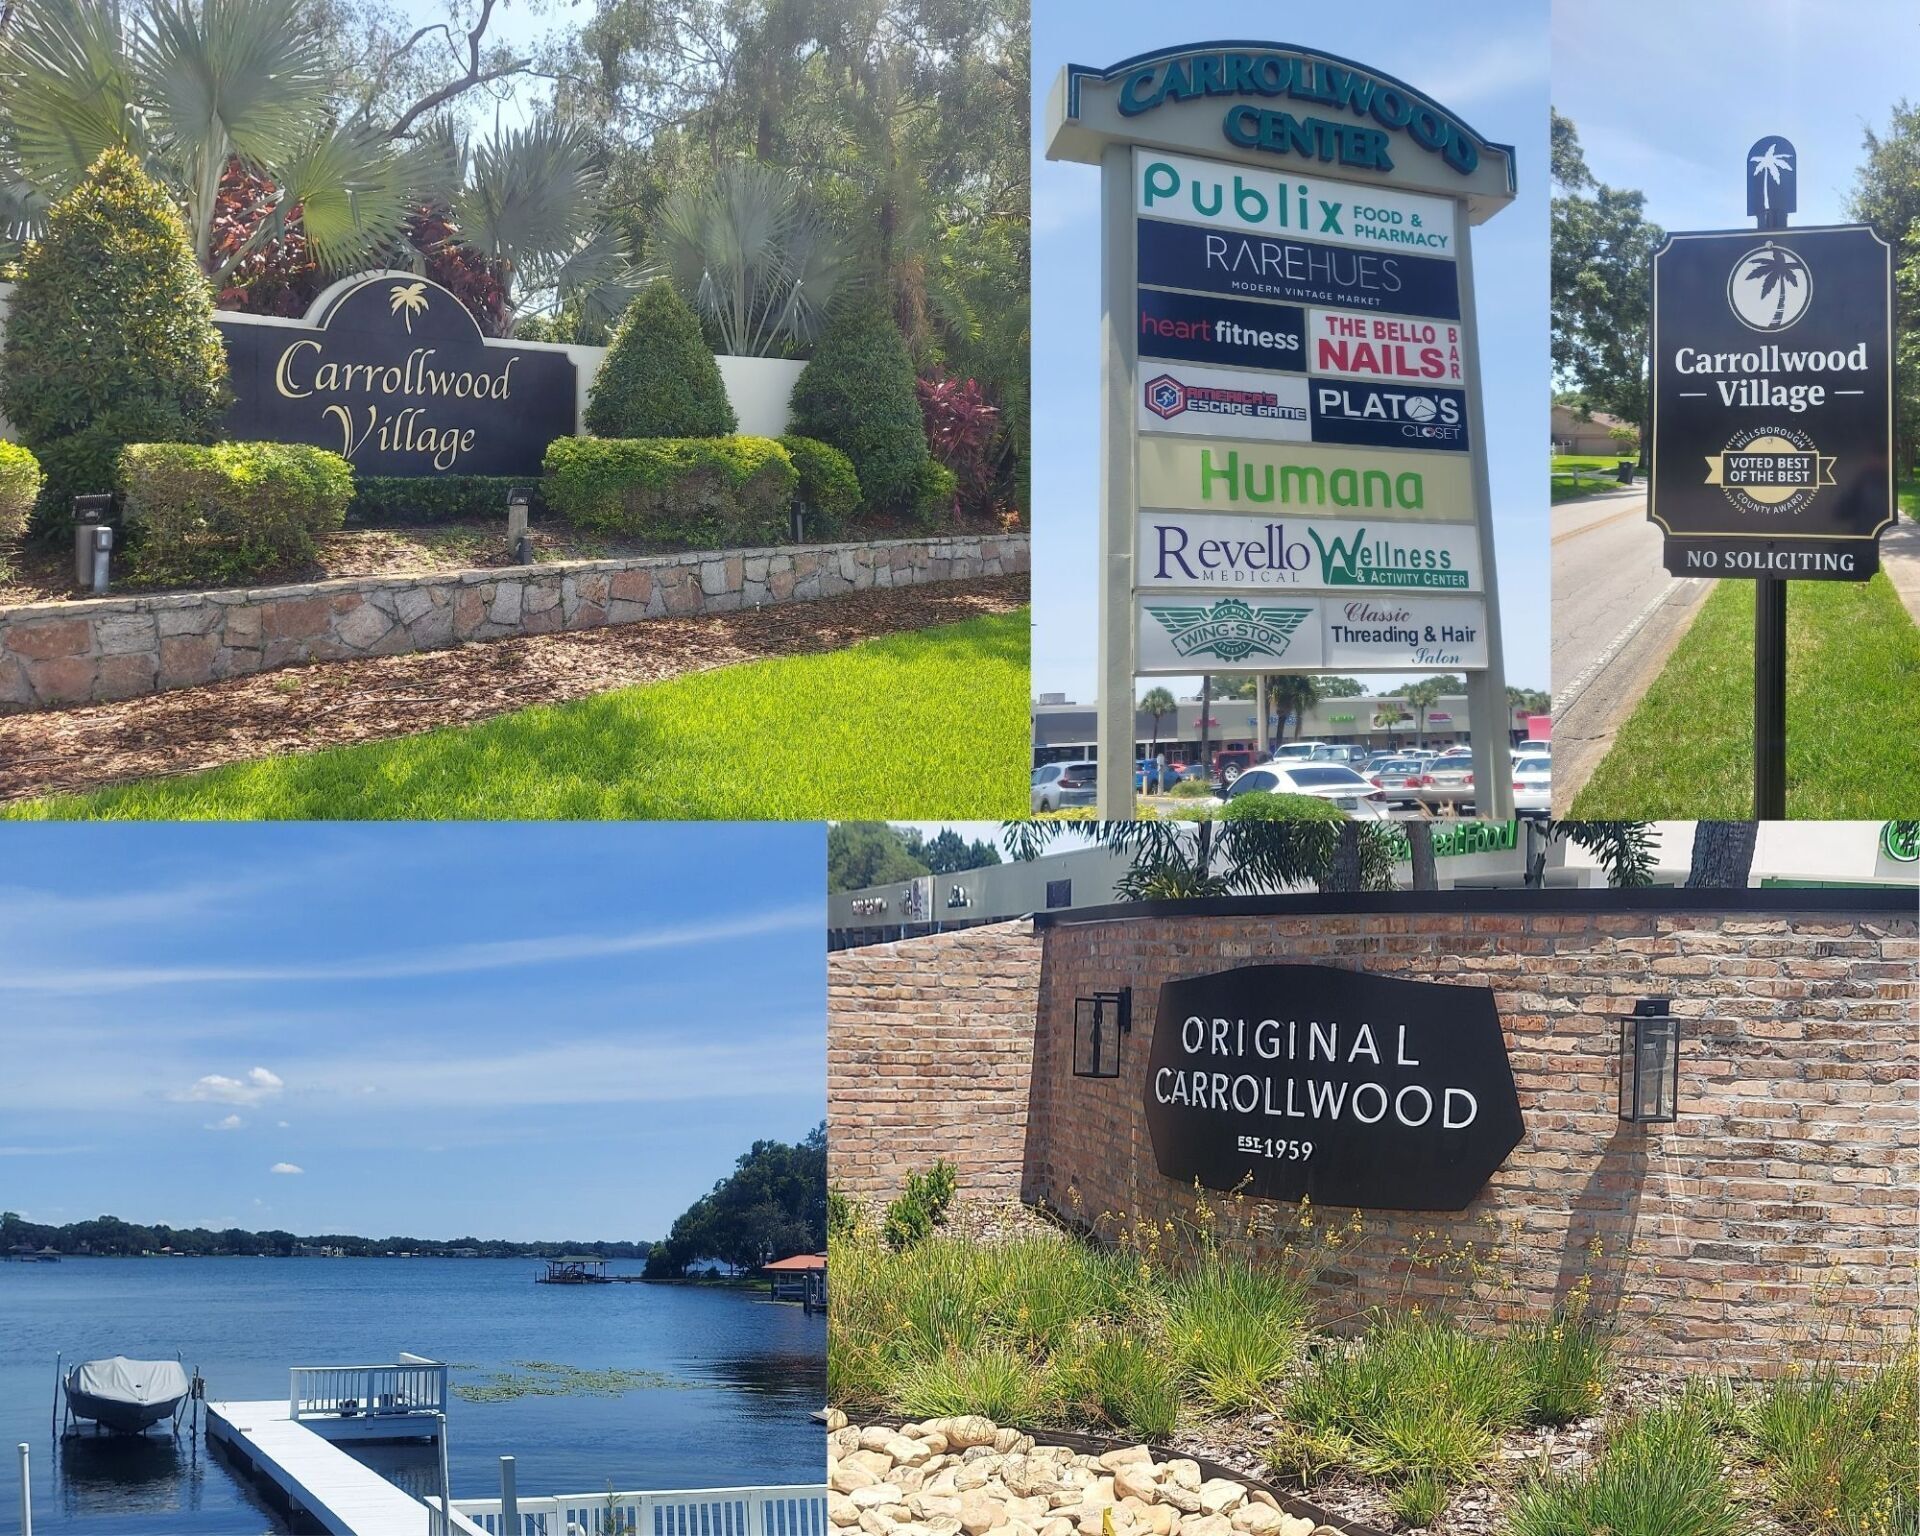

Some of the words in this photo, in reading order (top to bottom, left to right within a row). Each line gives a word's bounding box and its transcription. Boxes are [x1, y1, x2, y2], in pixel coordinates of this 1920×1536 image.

[1117, 53, 1478, 175] CARROLLWOOD
[1223, 105, 1395, 172] CENTER
[1144, 162, 1344, 234] Publix
[1354, 205, 1404, 224] FOOD
[1411, 214, 1423, 228] &
[1354, 225, 1448, 249] PHARMACY
[1205, 234, 1402, 292] RAREHUES
[1231, 280, 1281, 294] MODERN
[1285, 287, 1333, 301] VINTAGE
[1337, 294, 1381, 306] MARKET
[1141, 311, 1212, 342] heart
[1214, 320, 1300, 352] fitness
[1325, 316, 1367, 339] THE
[1373, 321, 1436, 345] BELLO
[1318, 338, 1447, 380] NAILS
[1447, 327, 1462, 380] BAR
[1675, 343, 1868, 374] Carrollwood
[275, 340, 520, 399] Carrollwood
[1185, 385, 1279, 406] AMERICA'S
[1187, 400, 1253, 415] ESCAPE
[1257, 405, 1307, 421] GAME
[1319, 389, 1460, 424] PLATO'S
[1717, 379, 1825, 413] Village
[322, 405, 475, 471] Village
[1402, 424, 1461, 440] CLOSET
[1736, 426, 1805, 449] HILLSBOROUGH
[1730, 457, 1773, 468] VOTED
[1778, 457, 1810, 468] BEST
[1730, 471, 1747, 482] OF
[1749, 471, 1774, 482] THE
[1778, 471, 1810, 482] BEST
[1201, 449, 1424, 510] Humana
[1736, 492, 1771, 514] COUNTY
[1773, 493, 1803, 514] AWARD
[1153, 523, 1311, 580] Revello
[1307, 526, 1452, 586] Wellness
[1686, 551, 1718, 567] NO
[1724, 552, 1855, 571] SOLICITING
[1202, 570, 1300, 583] MEDICAL
[1356, 570, 1366, 583] &
[1371, 570, 1419, 585] ACTIVITY
[1423, 572, 1467, 587] CENTER
[1344, 602, 1412, 622] Classic
[1331, 625, 1418, 646] Threading
[1424, 625, 1436, 642] &
[1442, 626, 1476, 642] Hair
[1412, 647, 1461, 665] Salon
[1466, 819, 1516, 853] Food
[1182, 1016, 1420, 1066] ORIGINAL
[1155, 1067, 1478, 1129] CARROLLWOOD
[1264, 1138, 1313, 1161] 1959
